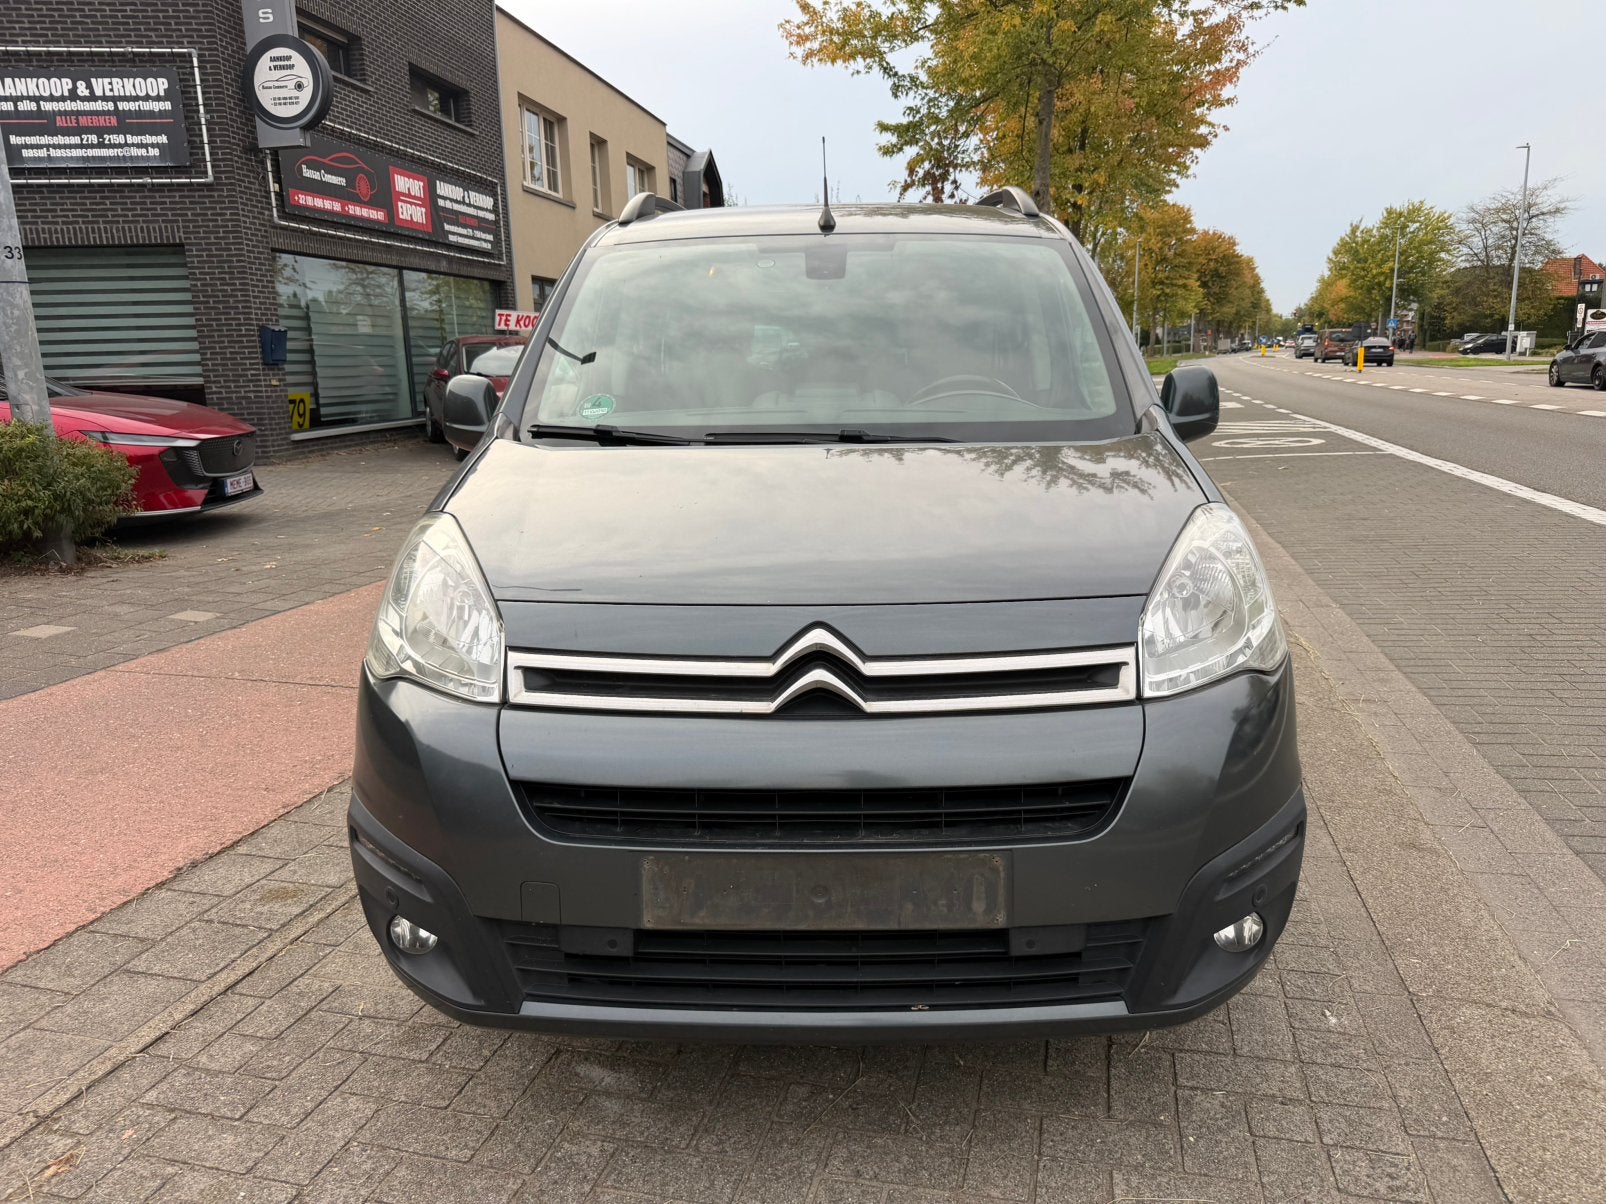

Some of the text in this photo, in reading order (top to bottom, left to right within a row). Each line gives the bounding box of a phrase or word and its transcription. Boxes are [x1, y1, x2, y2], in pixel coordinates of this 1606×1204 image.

[258, 8, 273, 23] S
[76, 80, 90, 96] &
[91, 77, 169, 97] VERKOOP
[0, 100, 172, 112] an alle tweedehandse voertuigen
[56, 115, 118, 127] ALLE MERKEN
[9, 134, 81, 145] Herentalsebaan
[81, 134, 98, 144] 279
[103, 134, 125, 144] 2150
[126, 133, 168, 144] Borsbeek
[394, 173, 425, 199] IMPORT
[397, 201, 427, 225] EXPORT
[3, 245, 23, 260] 33
[497, 313, 512, 328] TE
